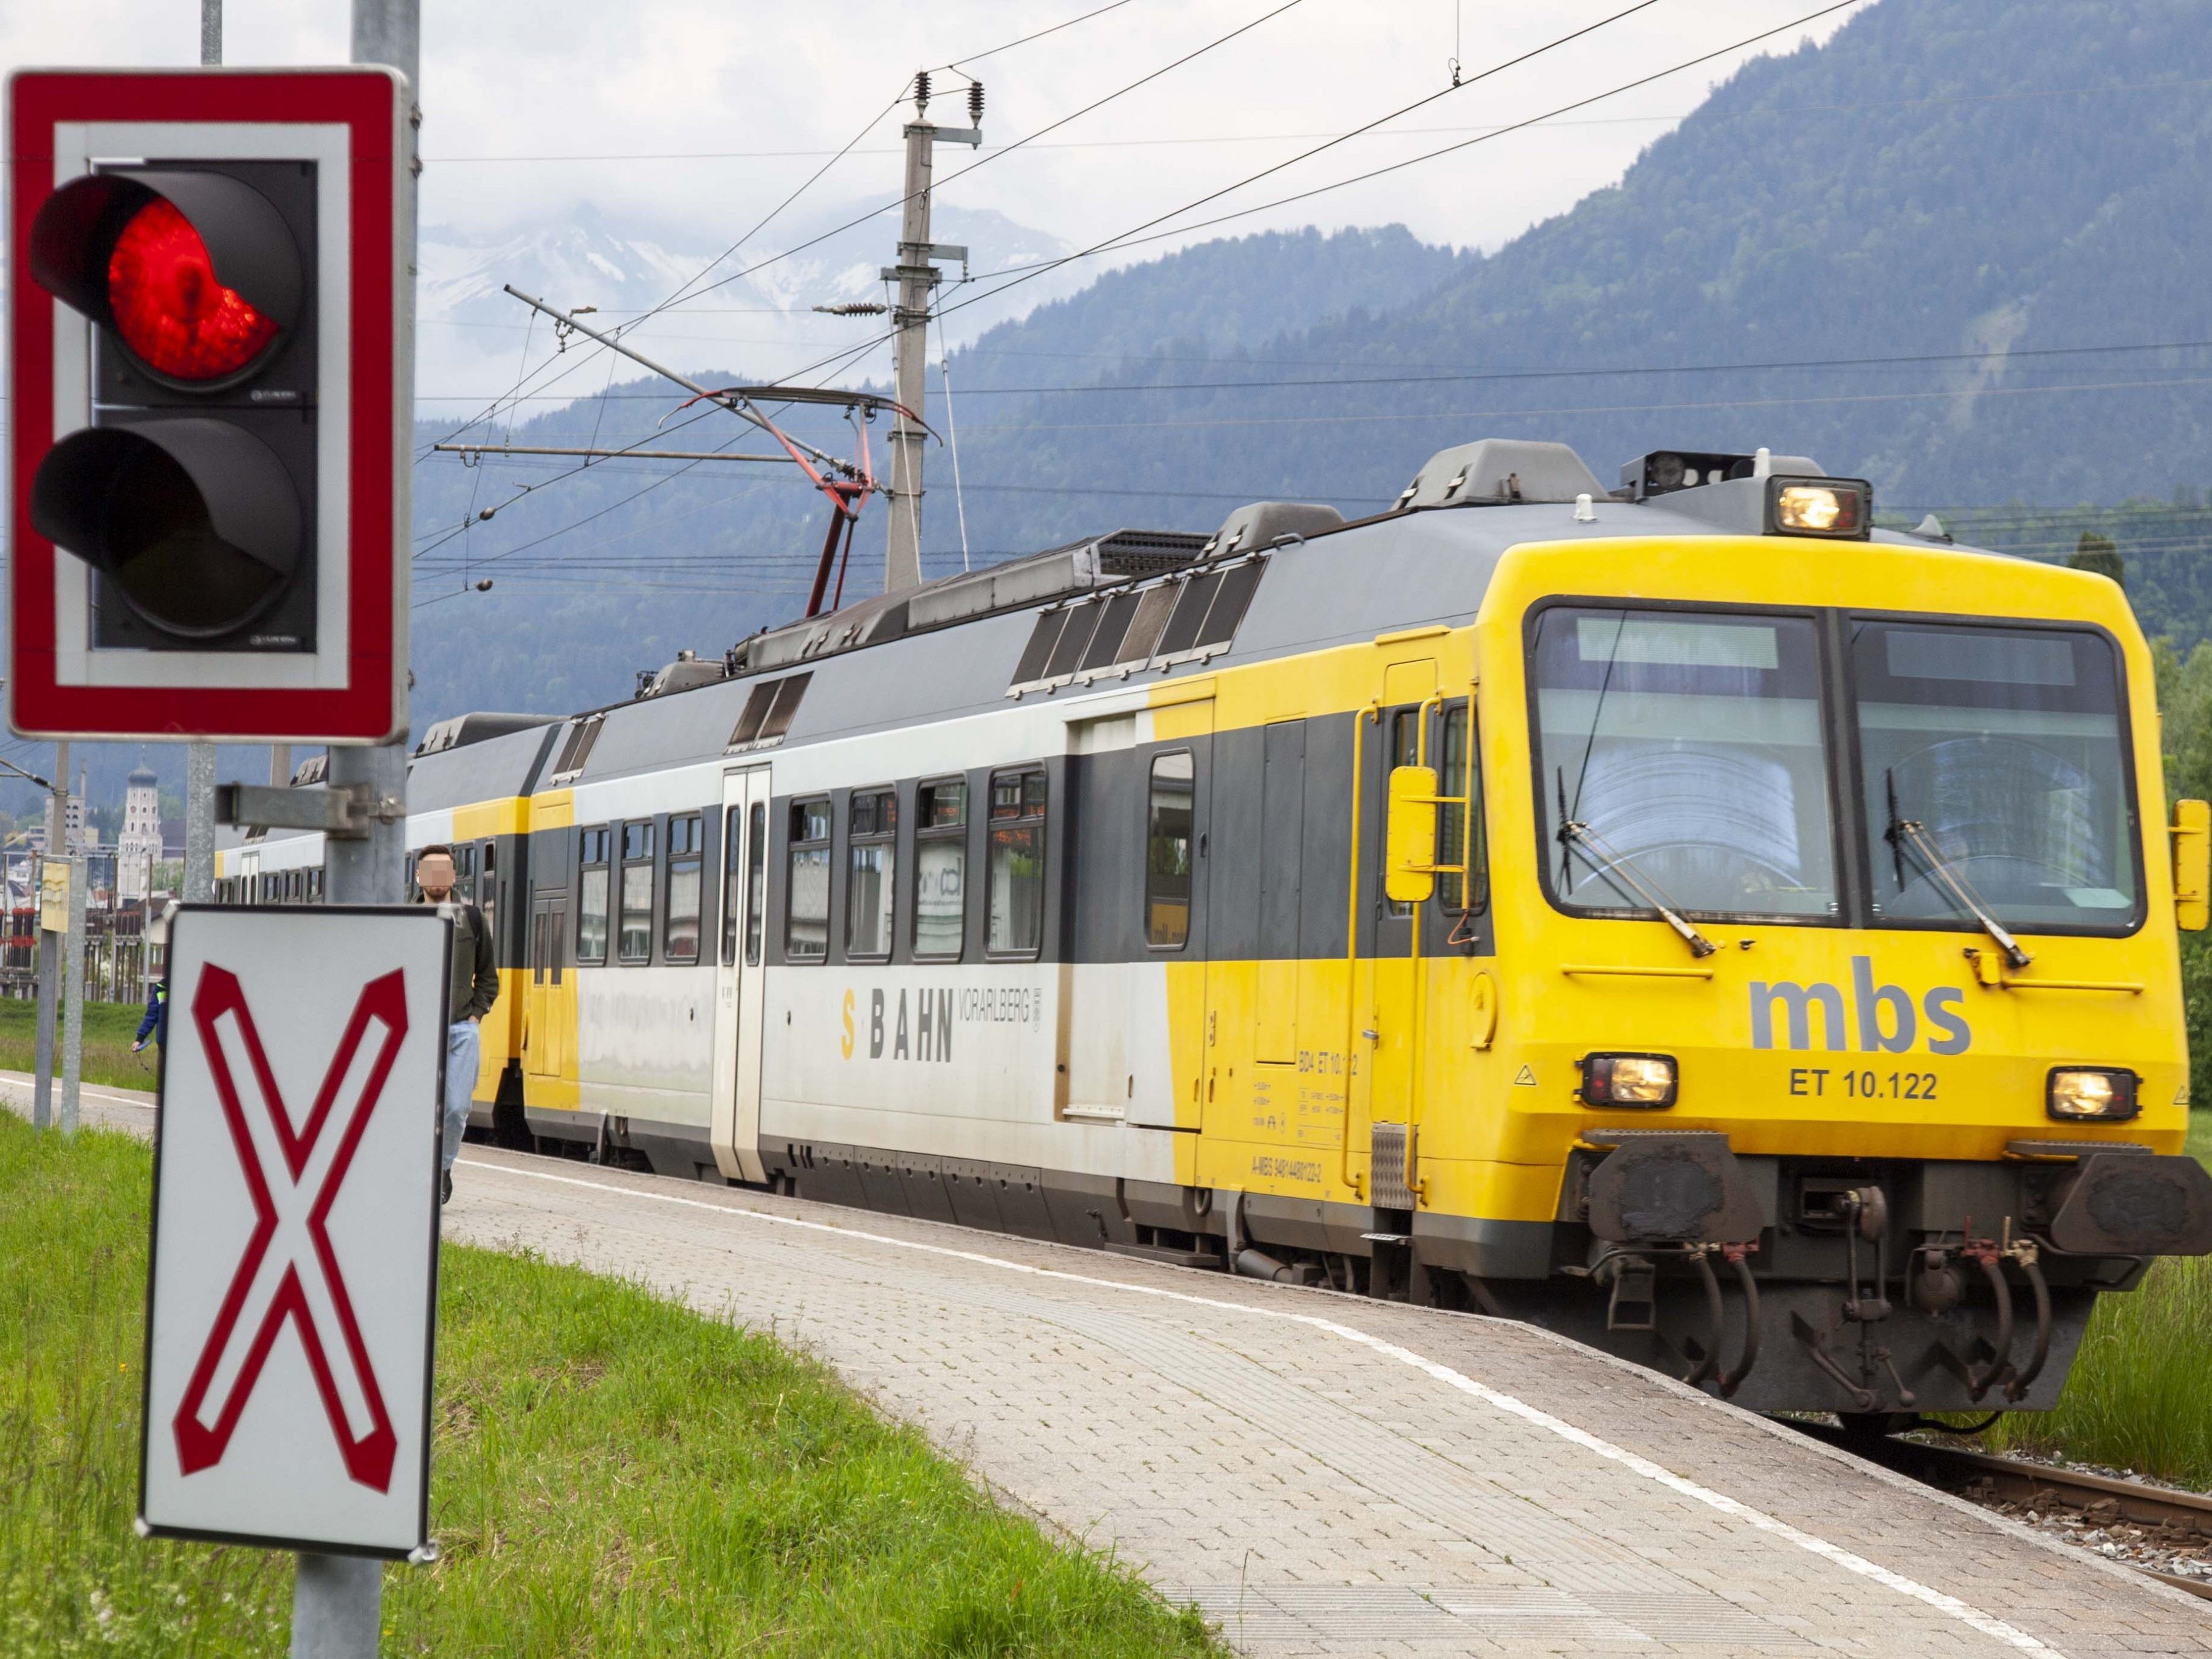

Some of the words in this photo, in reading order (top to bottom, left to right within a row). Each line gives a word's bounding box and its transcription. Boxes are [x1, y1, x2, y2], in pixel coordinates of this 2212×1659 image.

[841, 987, 855, 1060] S
[870, 987, 953, 1063] BAHN
[958, 987, 1029, 1022] VORARLBERG
[1749, 956, 1971, 1055] mbs
[1790, 1068, 1830, 1096] ET
[1843, 1070, 1937, 1100] 10.122
